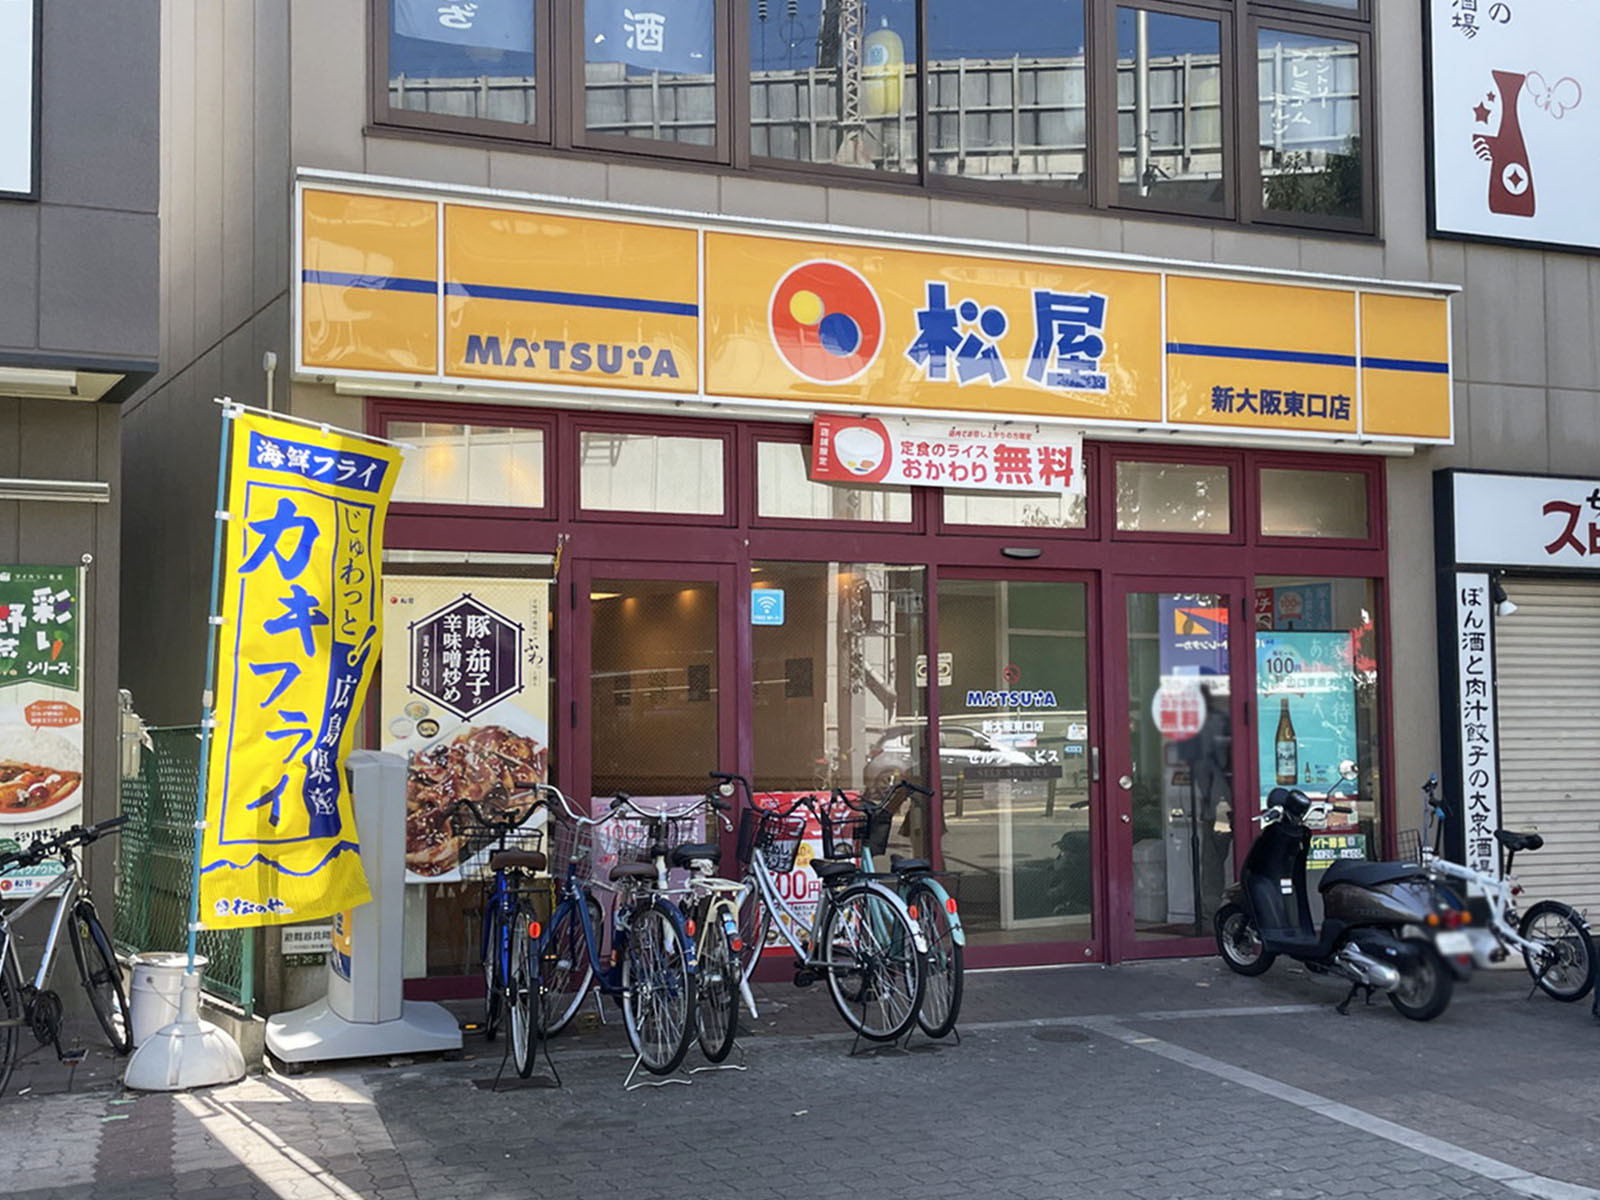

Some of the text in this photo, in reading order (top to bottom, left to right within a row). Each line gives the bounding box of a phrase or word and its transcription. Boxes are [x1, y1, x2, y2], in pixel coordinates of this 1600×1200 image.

[624, 9, 665, 52] 酒
[1489, 3, 1511, 24] の
[465, 335, 679, 378] MATSUYA
[905, 281, 1109, 391] 松屋
[1211, 386, 1350, 421] 新大阪東口店
[256, 439, 378, 488] 海鮮フライ
[900, 441, 989, 458] 定食のライス
[902, 443, 1074, 487] おかわり 無料
[26, 661, 71, 676] シリーズ
[237, 497, 330, 827] カキフライ
[442, 613, 462, 703] 辛味噌炒め
[465, 614, 491, 705] 豚と茄子の
[966, 691, 1057, 707] MATSUYA
[308, 675, 358, 815] 広島県産
[232, 899, 284, 915] 松のや
[770, 871, 821, 900] 00円
